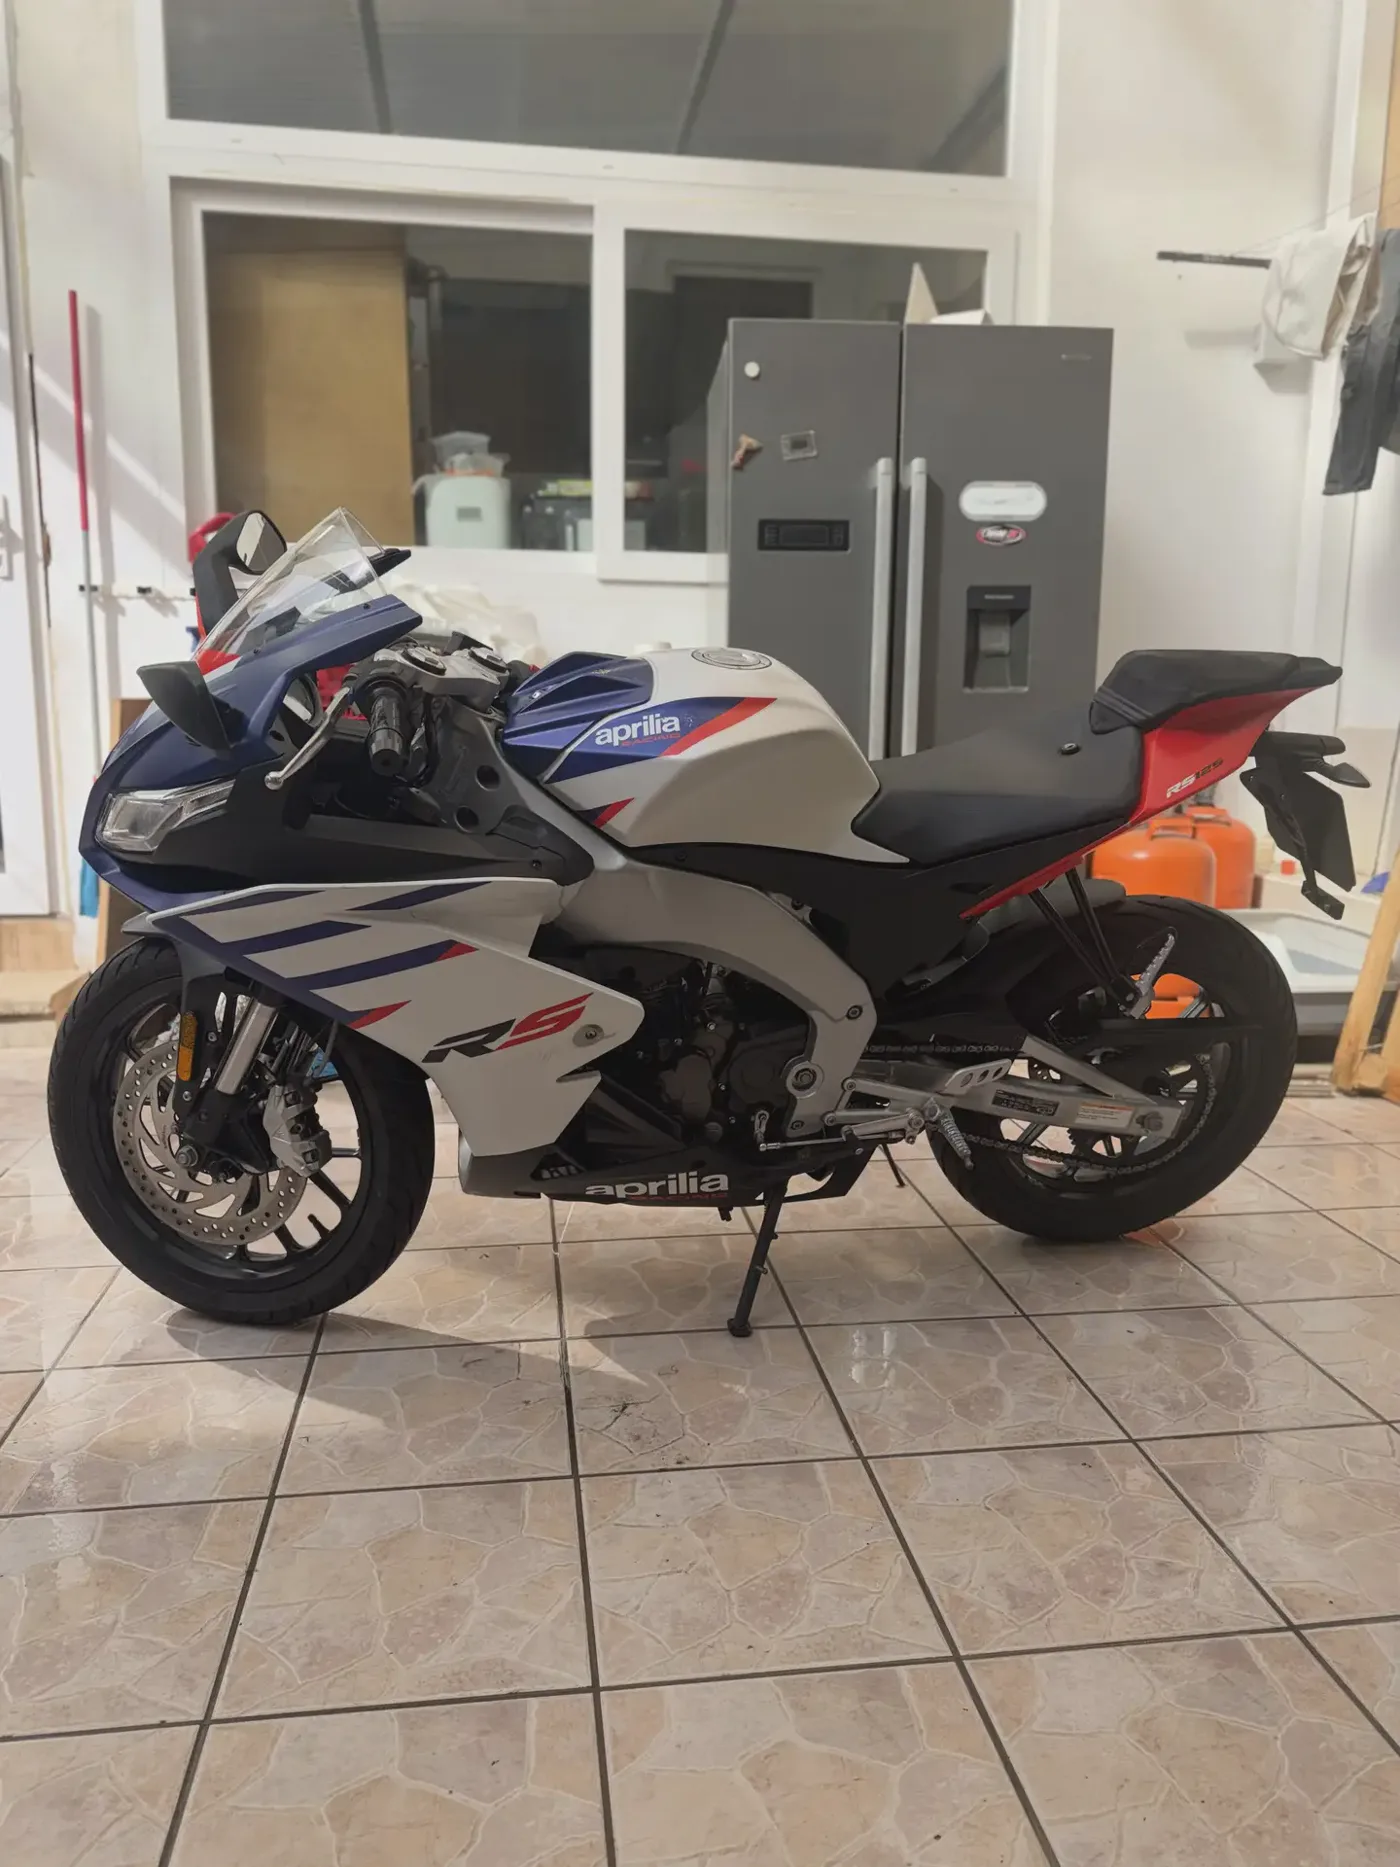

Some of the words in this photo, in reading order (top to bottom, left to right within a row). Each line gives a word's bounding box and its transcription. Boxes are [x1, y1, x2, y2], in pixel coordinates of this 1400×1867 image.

[595, 713, 680, 746] aprilia
[421, 992, 594, 1063] RS
[585, 1171, 729, 1198] aprilia
